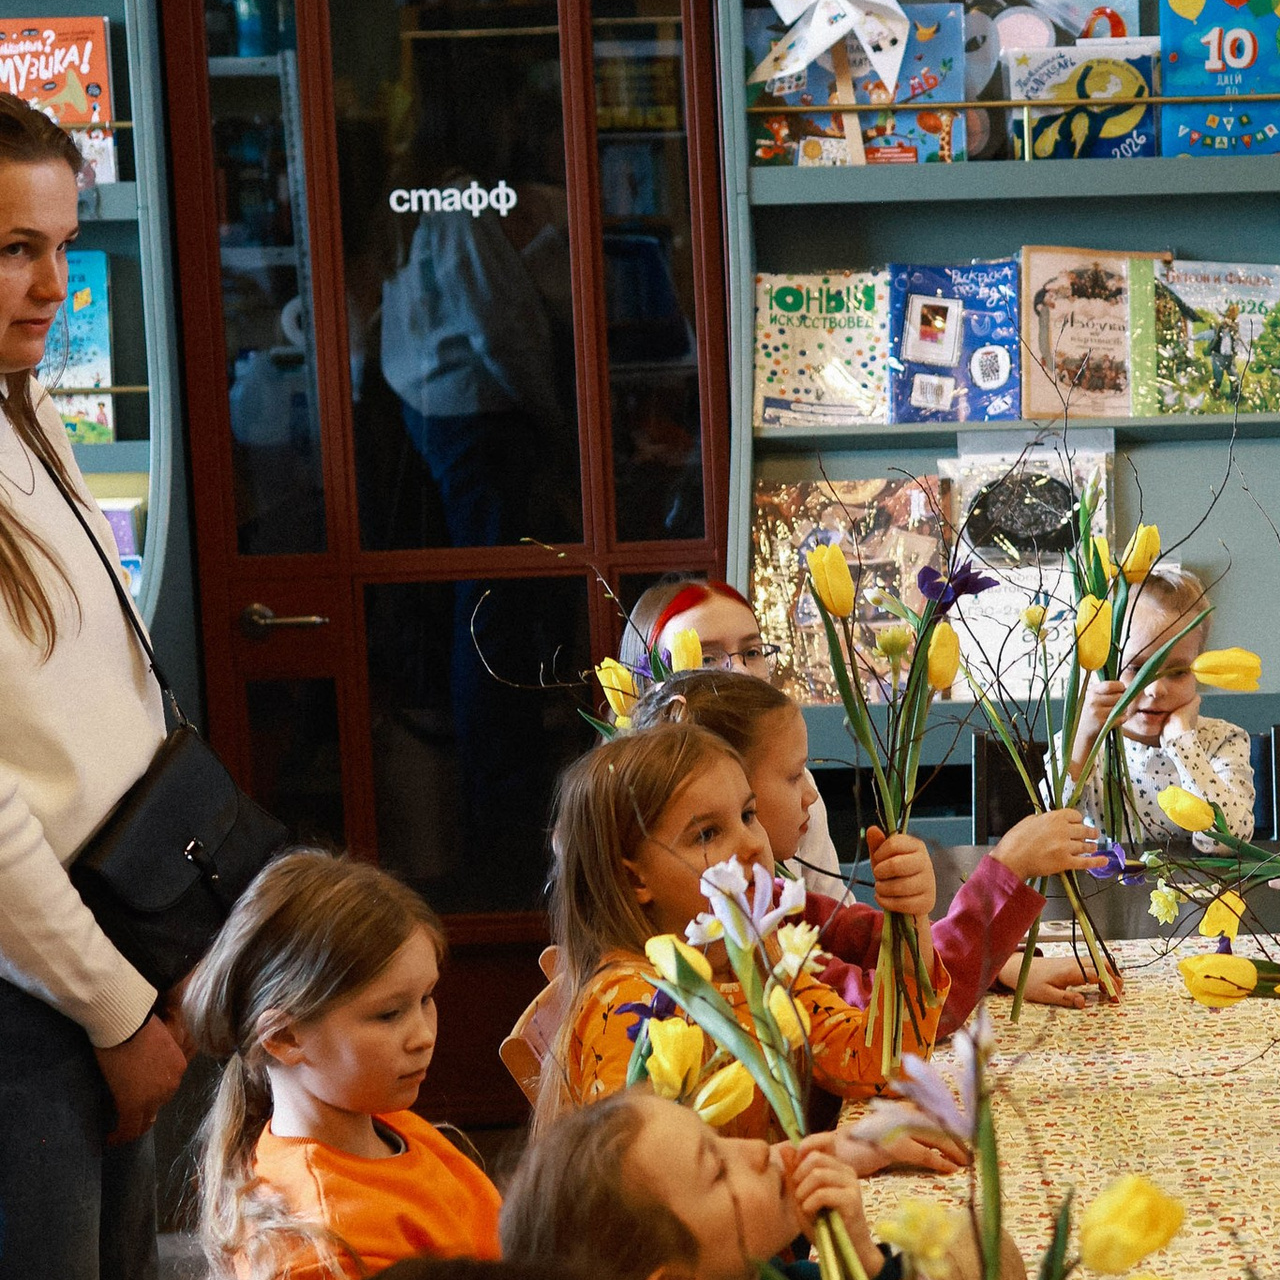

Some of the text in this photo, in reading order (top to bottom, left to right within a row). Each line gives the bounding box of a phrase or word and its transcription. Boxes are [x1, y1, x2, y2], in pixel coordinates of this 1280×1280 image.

[1200, 26, 1258, 72] 10
[1112, 130, 1146, 158] 2026
[388, 180, 518, 216] стафф
[768, 282, 876, 314] ЮНЫЙ
[769, 313, 874, 330] ИСКУССТВОВЕД
